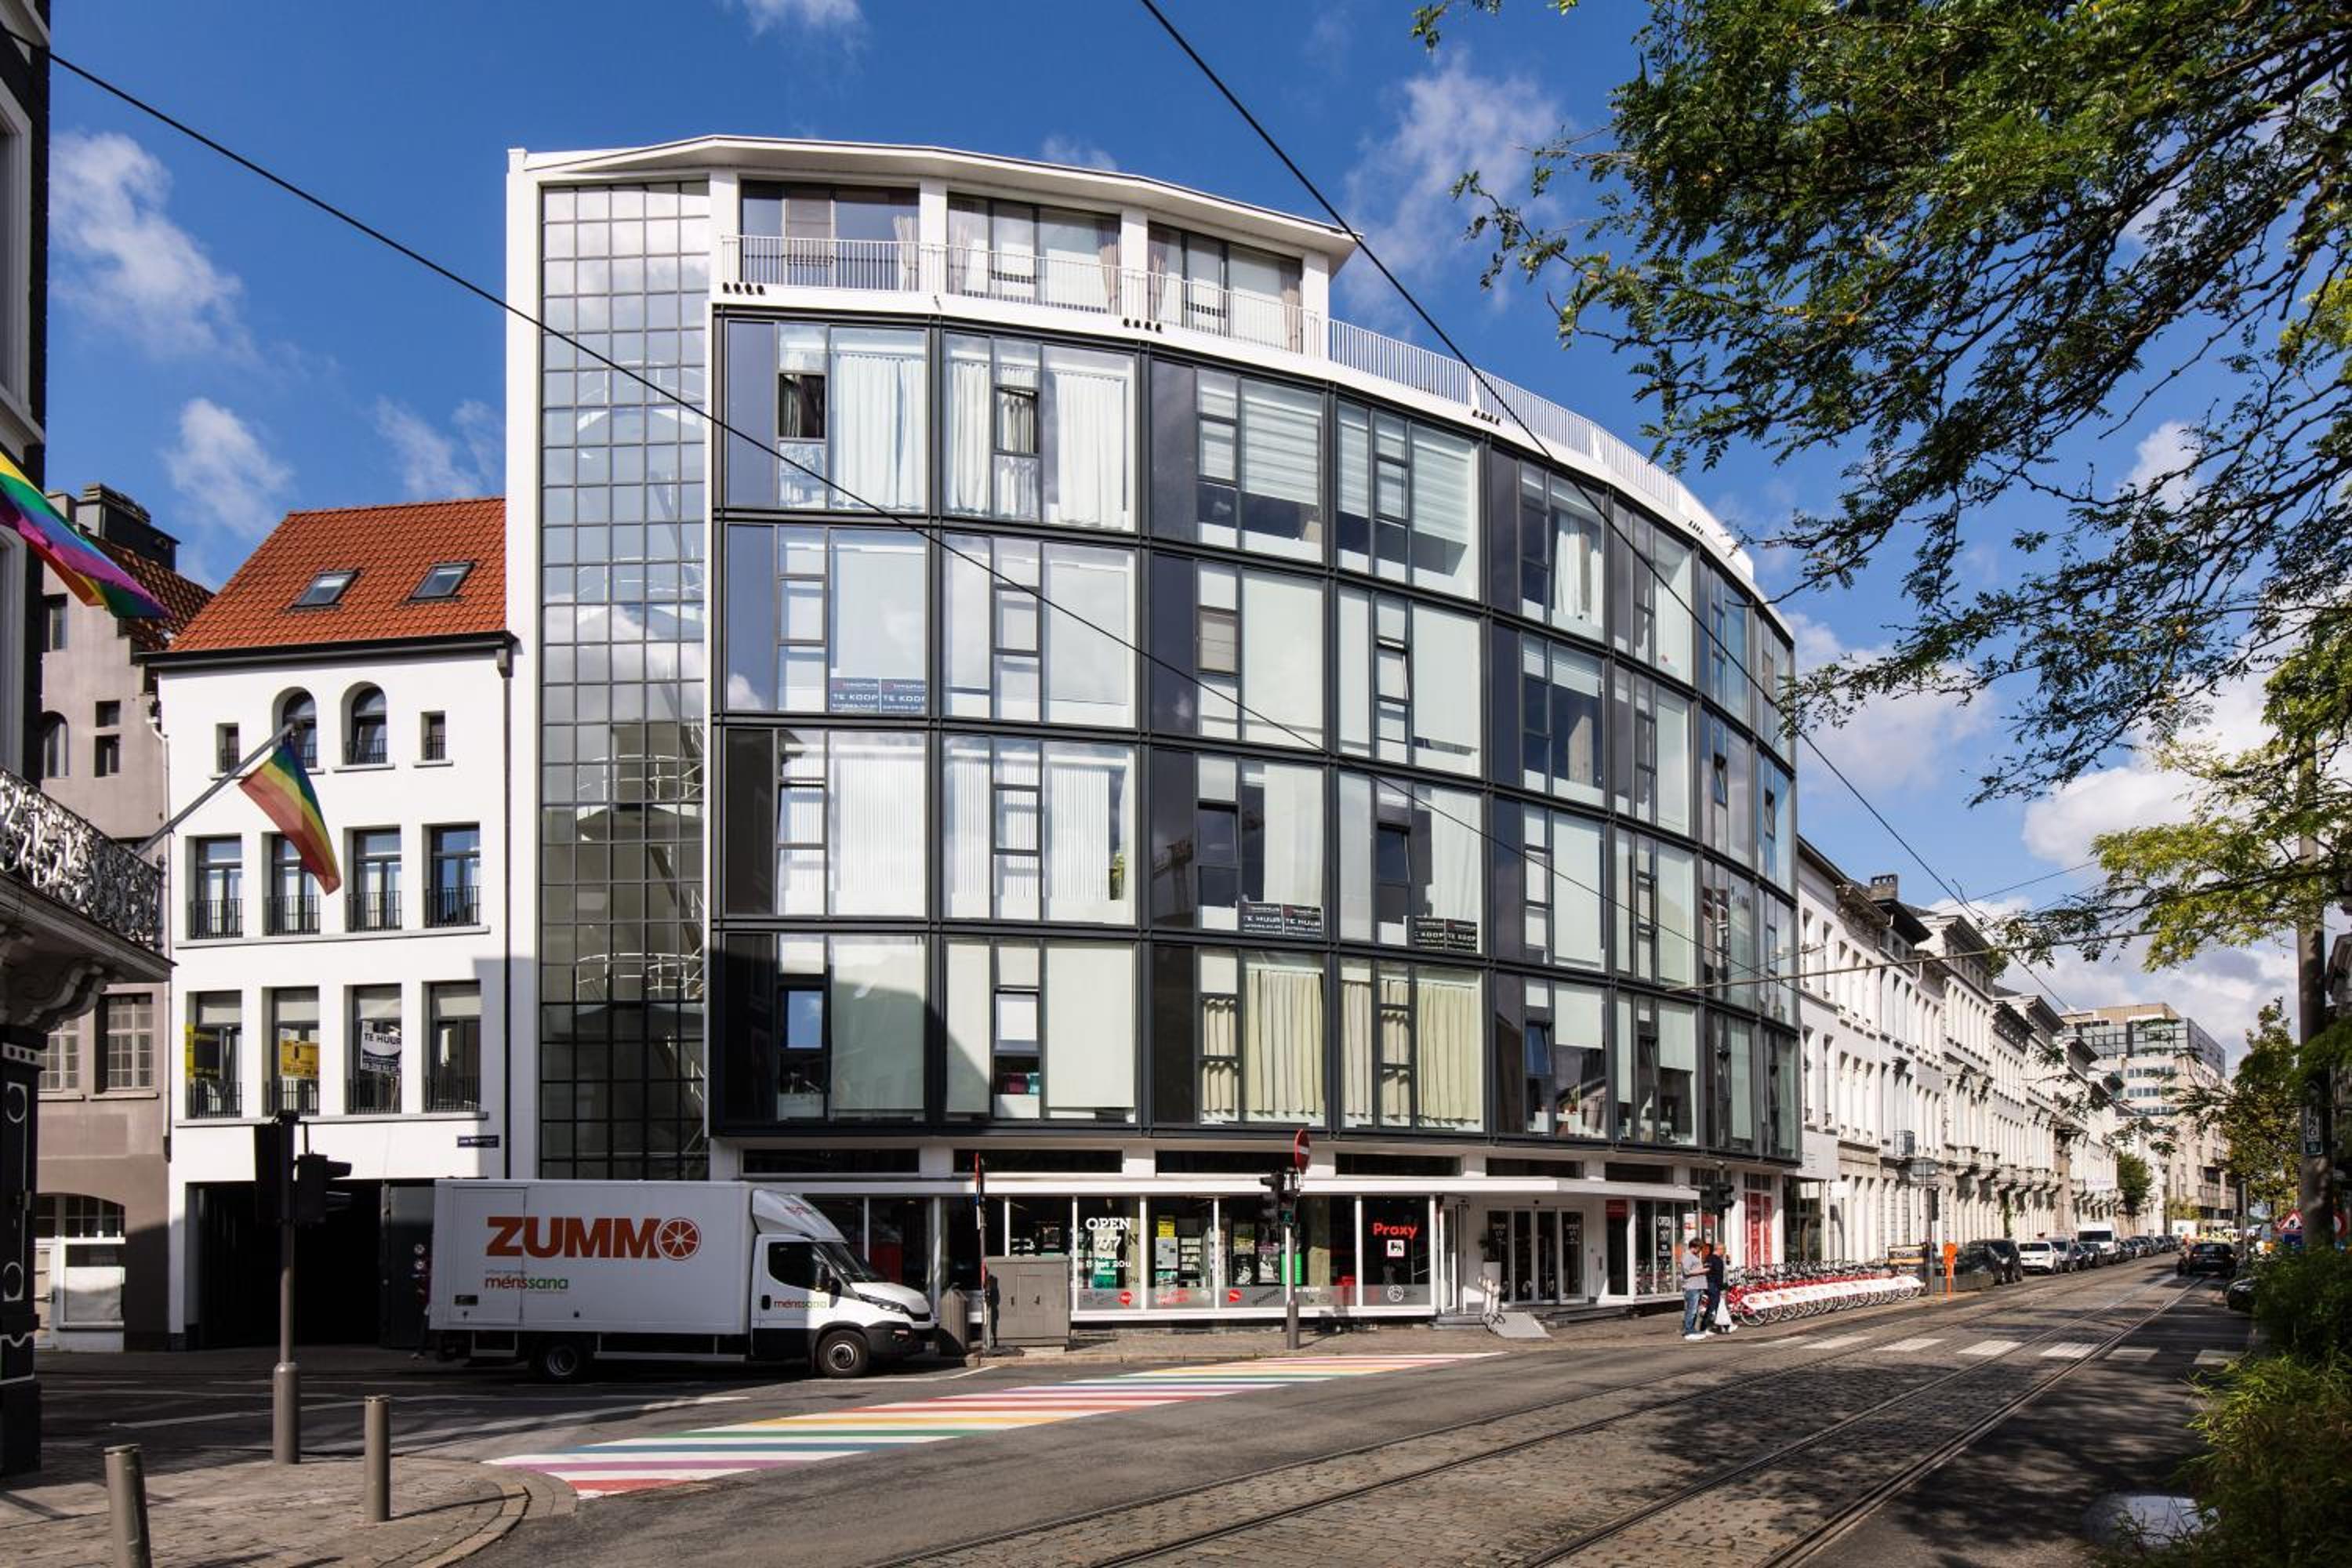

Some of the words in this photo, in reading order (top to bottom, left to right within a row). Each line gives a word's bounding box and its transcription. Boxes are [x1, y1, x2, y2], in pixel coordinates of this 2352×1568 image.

[364, 1033, 374, 1042] TE
[376, 1034, 401, 1045] HUUR
[1085, 1217, 1131, 1230] OPEN
[1373, 1222, 1417, 1239] Proxy
